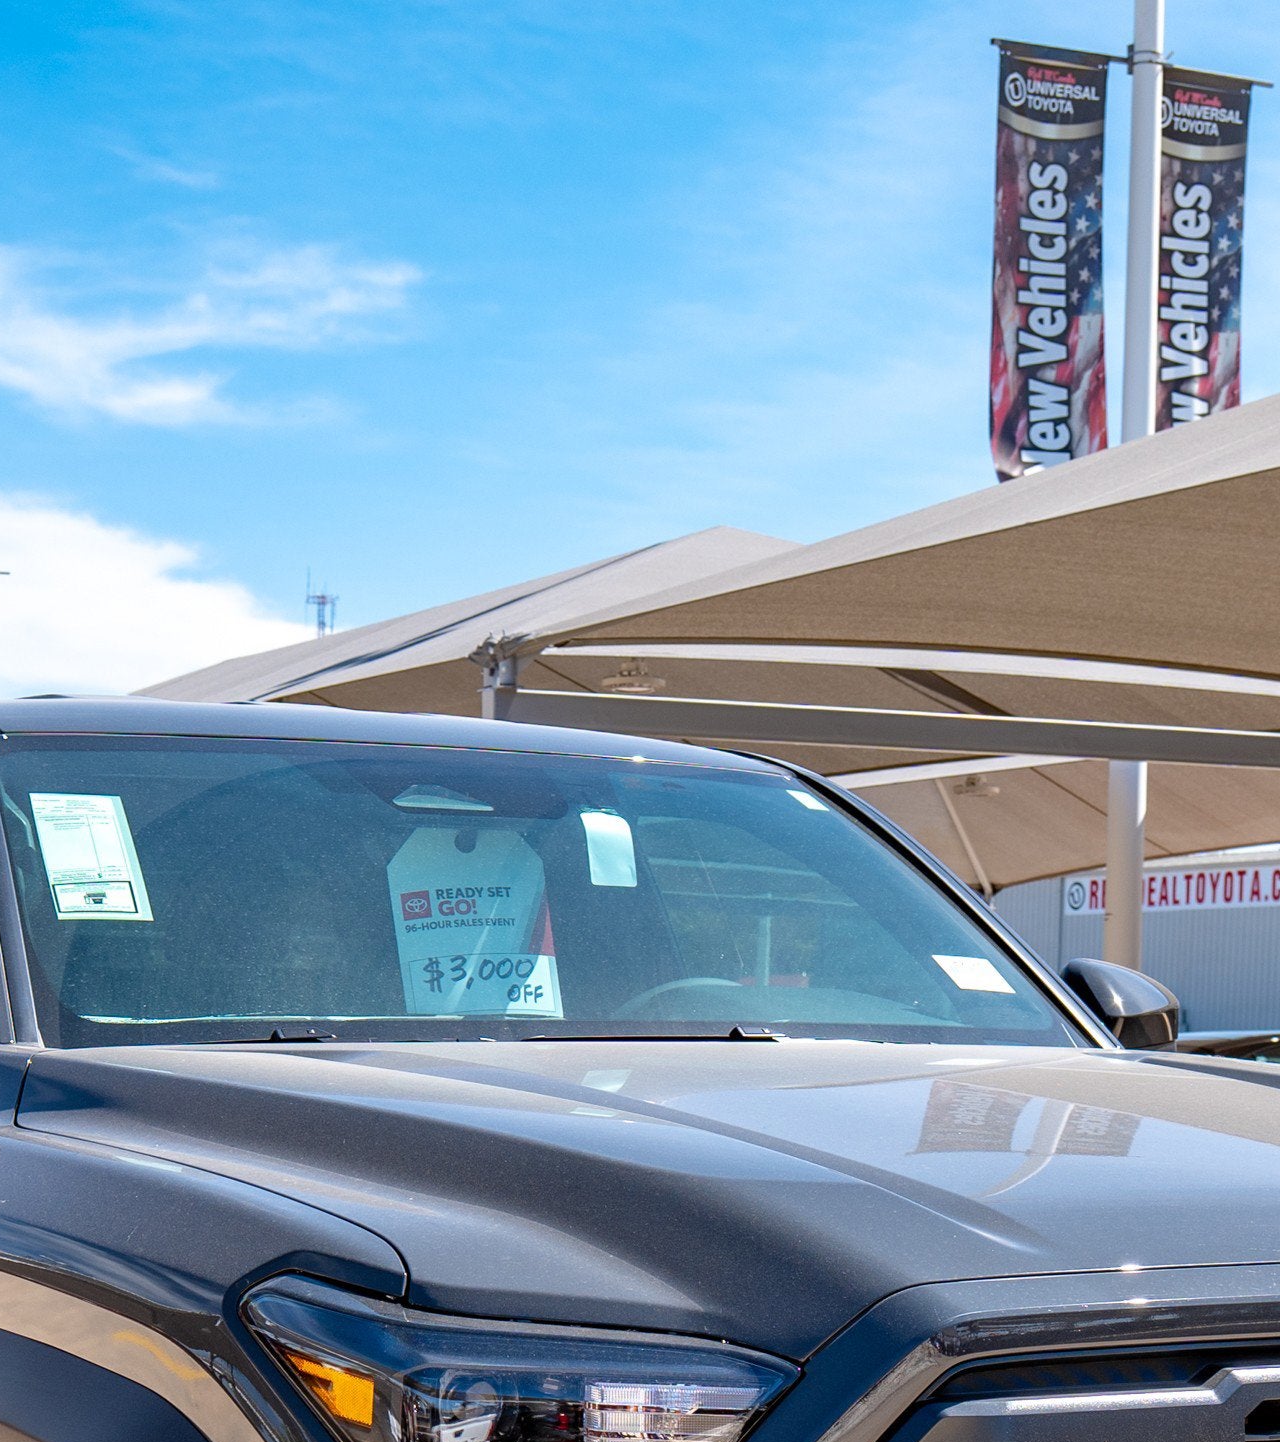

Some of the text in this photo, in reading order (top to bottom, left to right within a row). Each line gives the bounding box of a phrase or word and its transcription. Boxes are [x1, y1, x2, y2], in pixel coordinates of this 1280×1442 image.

[1027, 79, 1100, 101] UNIVERSAL
[1026, 94, 1075, 115] TOYOTA
[1174, 101, 1243, 125] UNIVERSAL
[1173, 116, 1220, 137] TOYOTA
[1017, 161, 1069, 368] Vehicles
[1159, 181, 1212, 382] Vehicles
[435, 887, 511, 899] READY SET
[438, 899, 478, 916] GO!
[405, 918, 516, 933] 96-HOUR SALES EVENT
[422, 955, 534, 993] $3,000
[507, 984, 544, 1003] OFF
